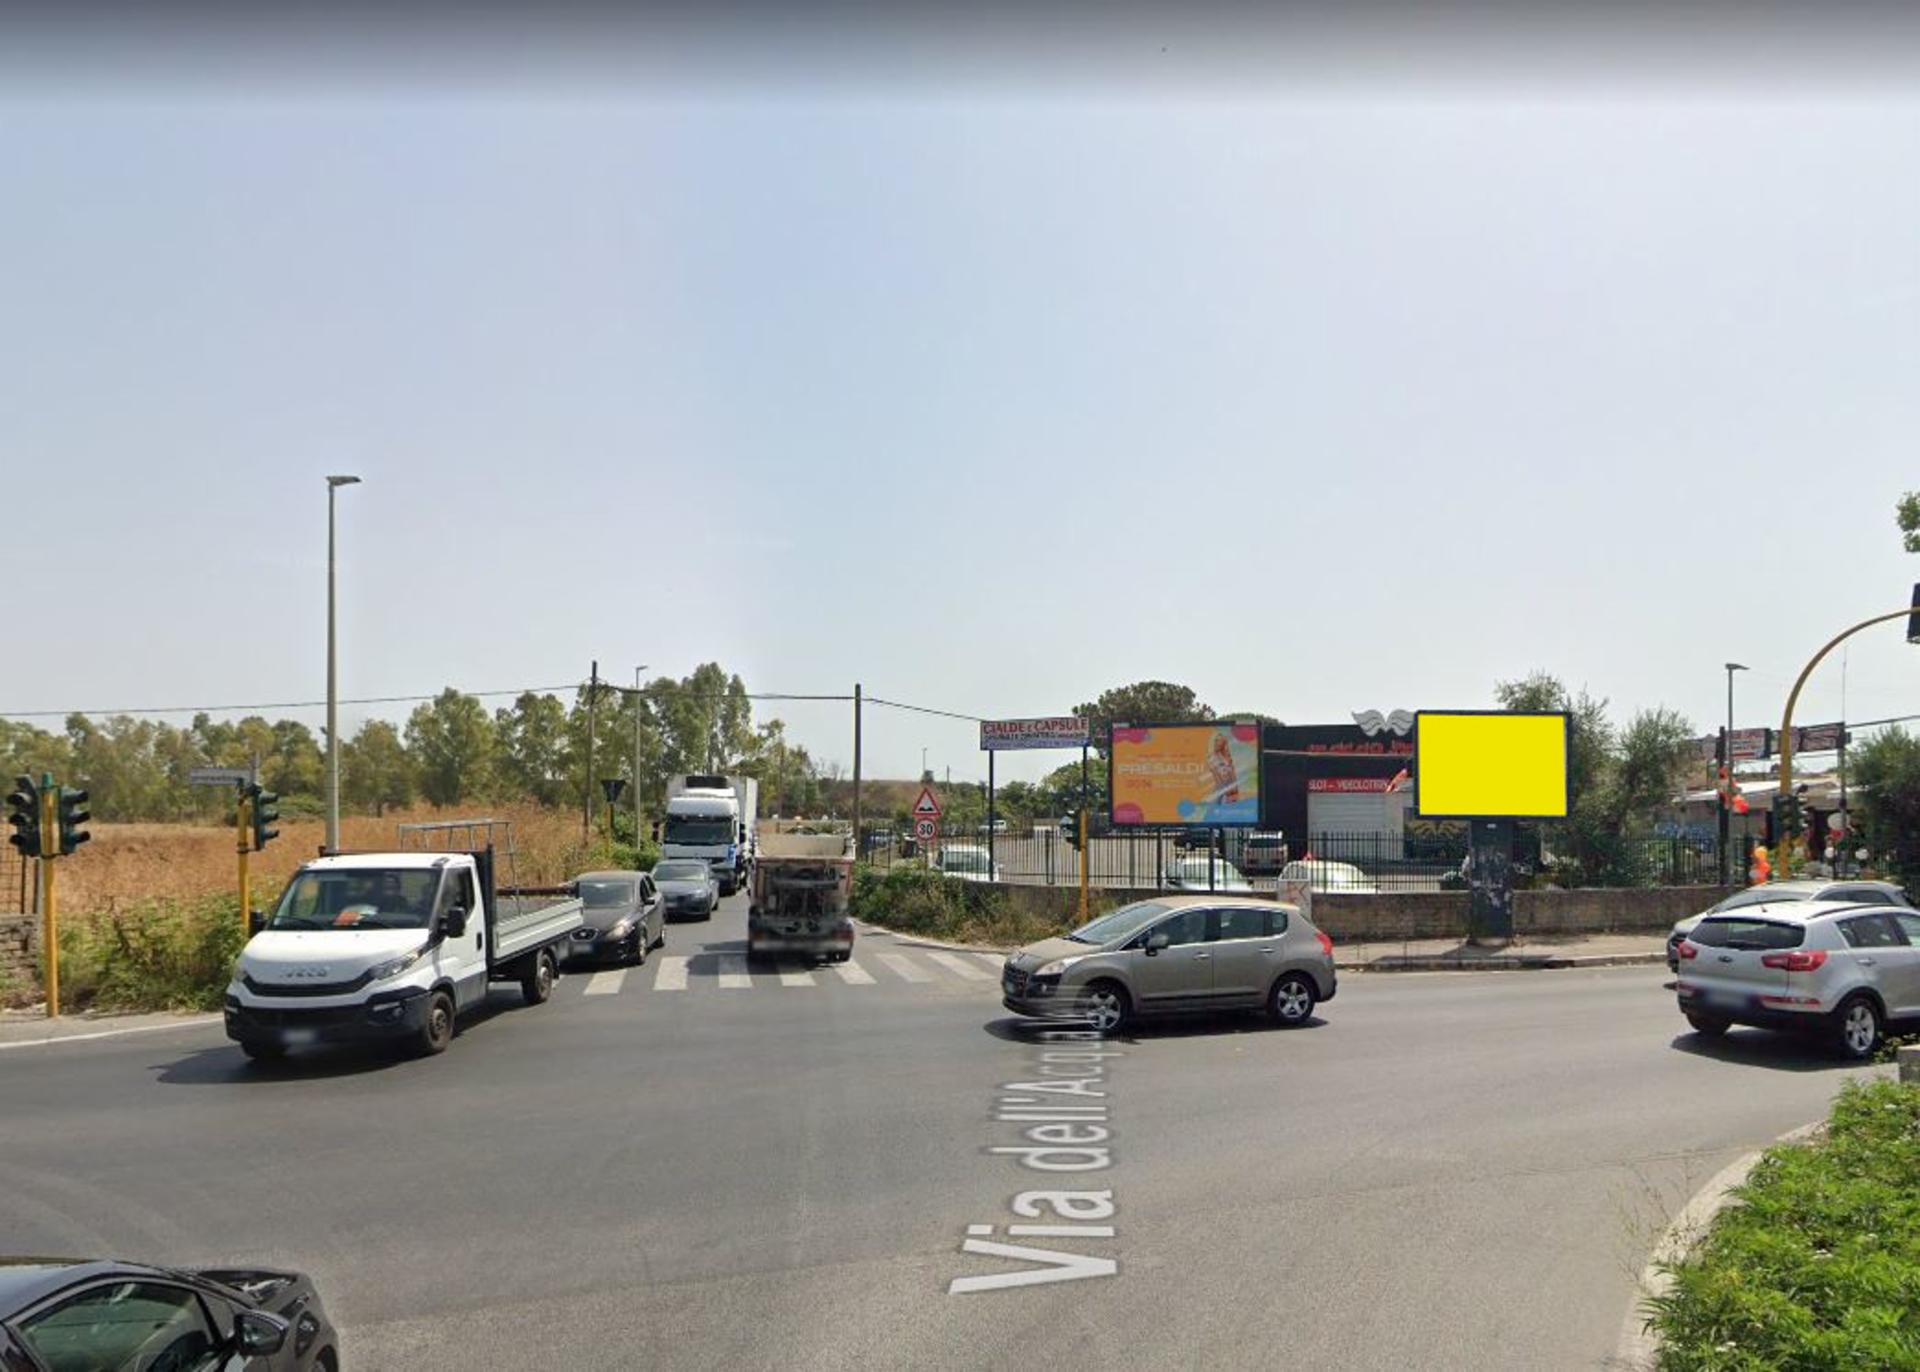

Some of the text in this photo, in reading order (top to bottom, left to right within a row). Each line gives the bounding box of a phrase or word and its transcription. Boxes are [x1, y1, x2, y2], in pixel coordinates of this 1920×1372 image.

[983, 722, 1025, 735] CIALDE
[1034, 718, 1089, 731] CAPSULE
[1117, 762, 1205, 776] PRESALDI
[1308, 779, 1327, 790] SLOT
[919, 823, 934, 836] 30
